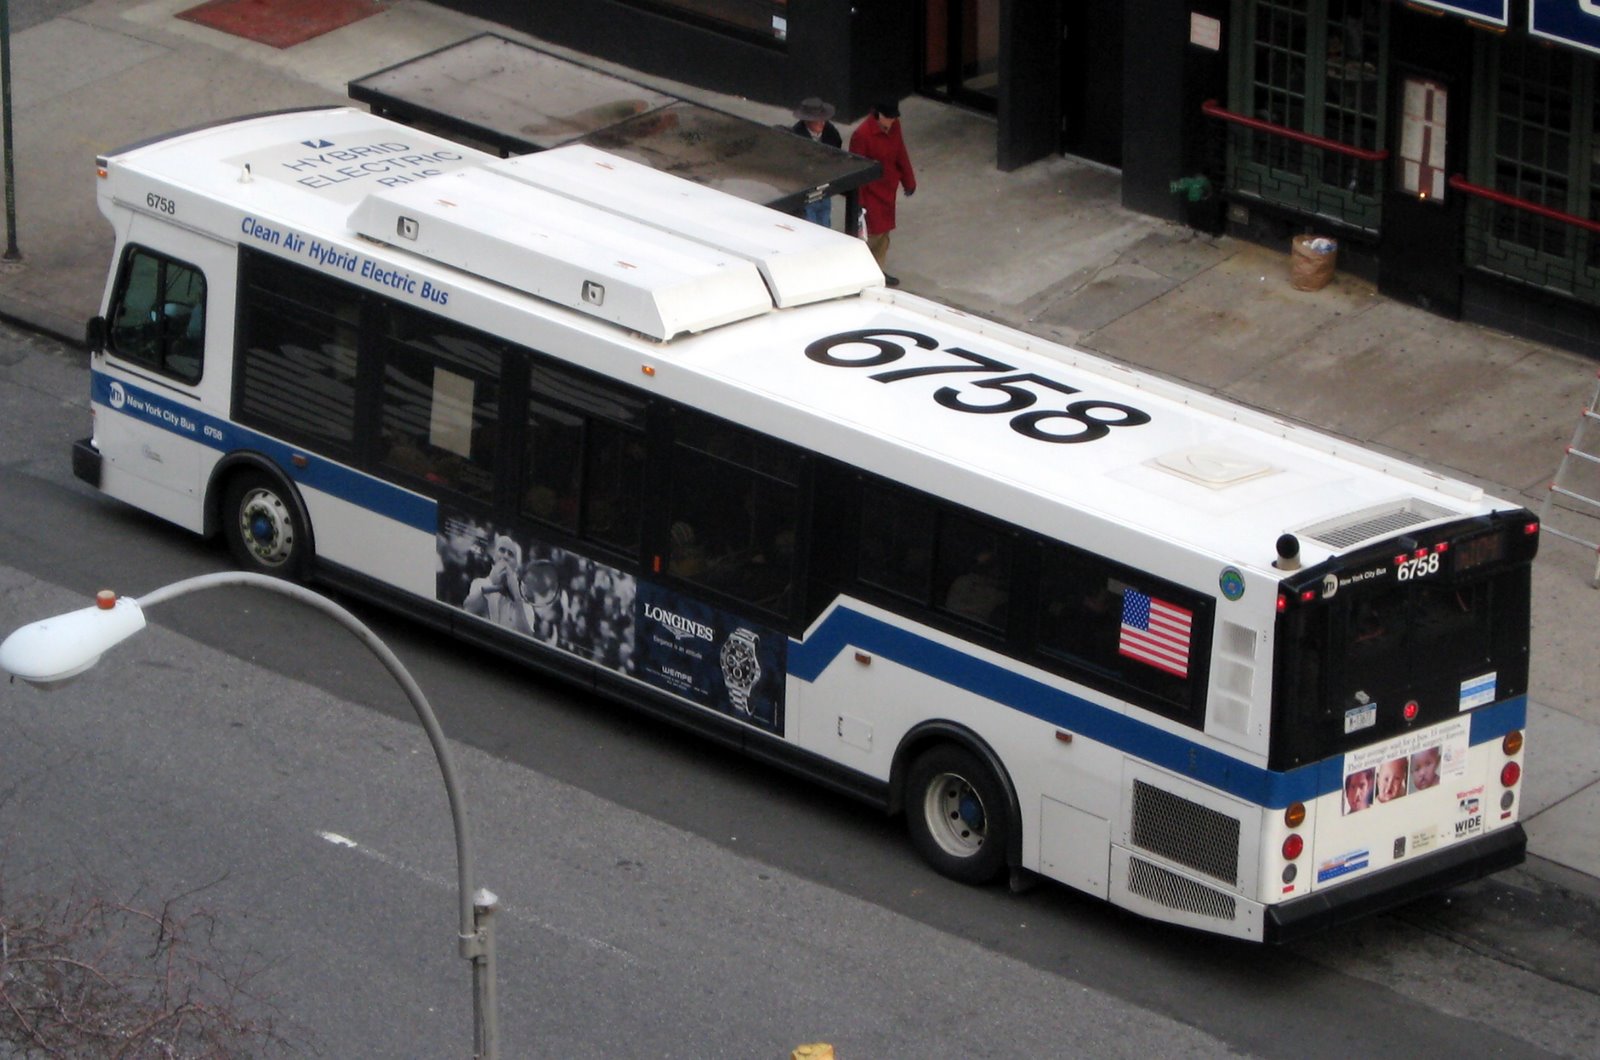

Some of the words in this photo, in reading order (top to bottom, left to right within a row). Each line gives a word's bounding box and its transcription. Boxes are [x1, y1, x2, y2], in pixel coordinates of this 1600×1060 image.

[282, 142, 410, 172] HYBRID
[297, 151, 463, 188] ELECTRIC
[146, 192, 175, 215] 6758
[241, 217, 280, 245] Clean
[284, 232, 305, 253] Air
[309, 242, 356, 272] Hybrid
[361, 260, 416, 294] Electric
[421, 281, 449, 305] Bus
[804, 328, 1152, 444] 6758
[127, 395, 145, 411] New
[144, 403, 162, 418] York
[163, 410, 180, 426] City
[180, 417, 196, 431] Bus
[203, 425, 223, 441] 6758
[1397, 552, 1440, 581] 6758
[644, 603, 714, 642] LONGINES
[1455, 815, 1482, 832] WIDE
